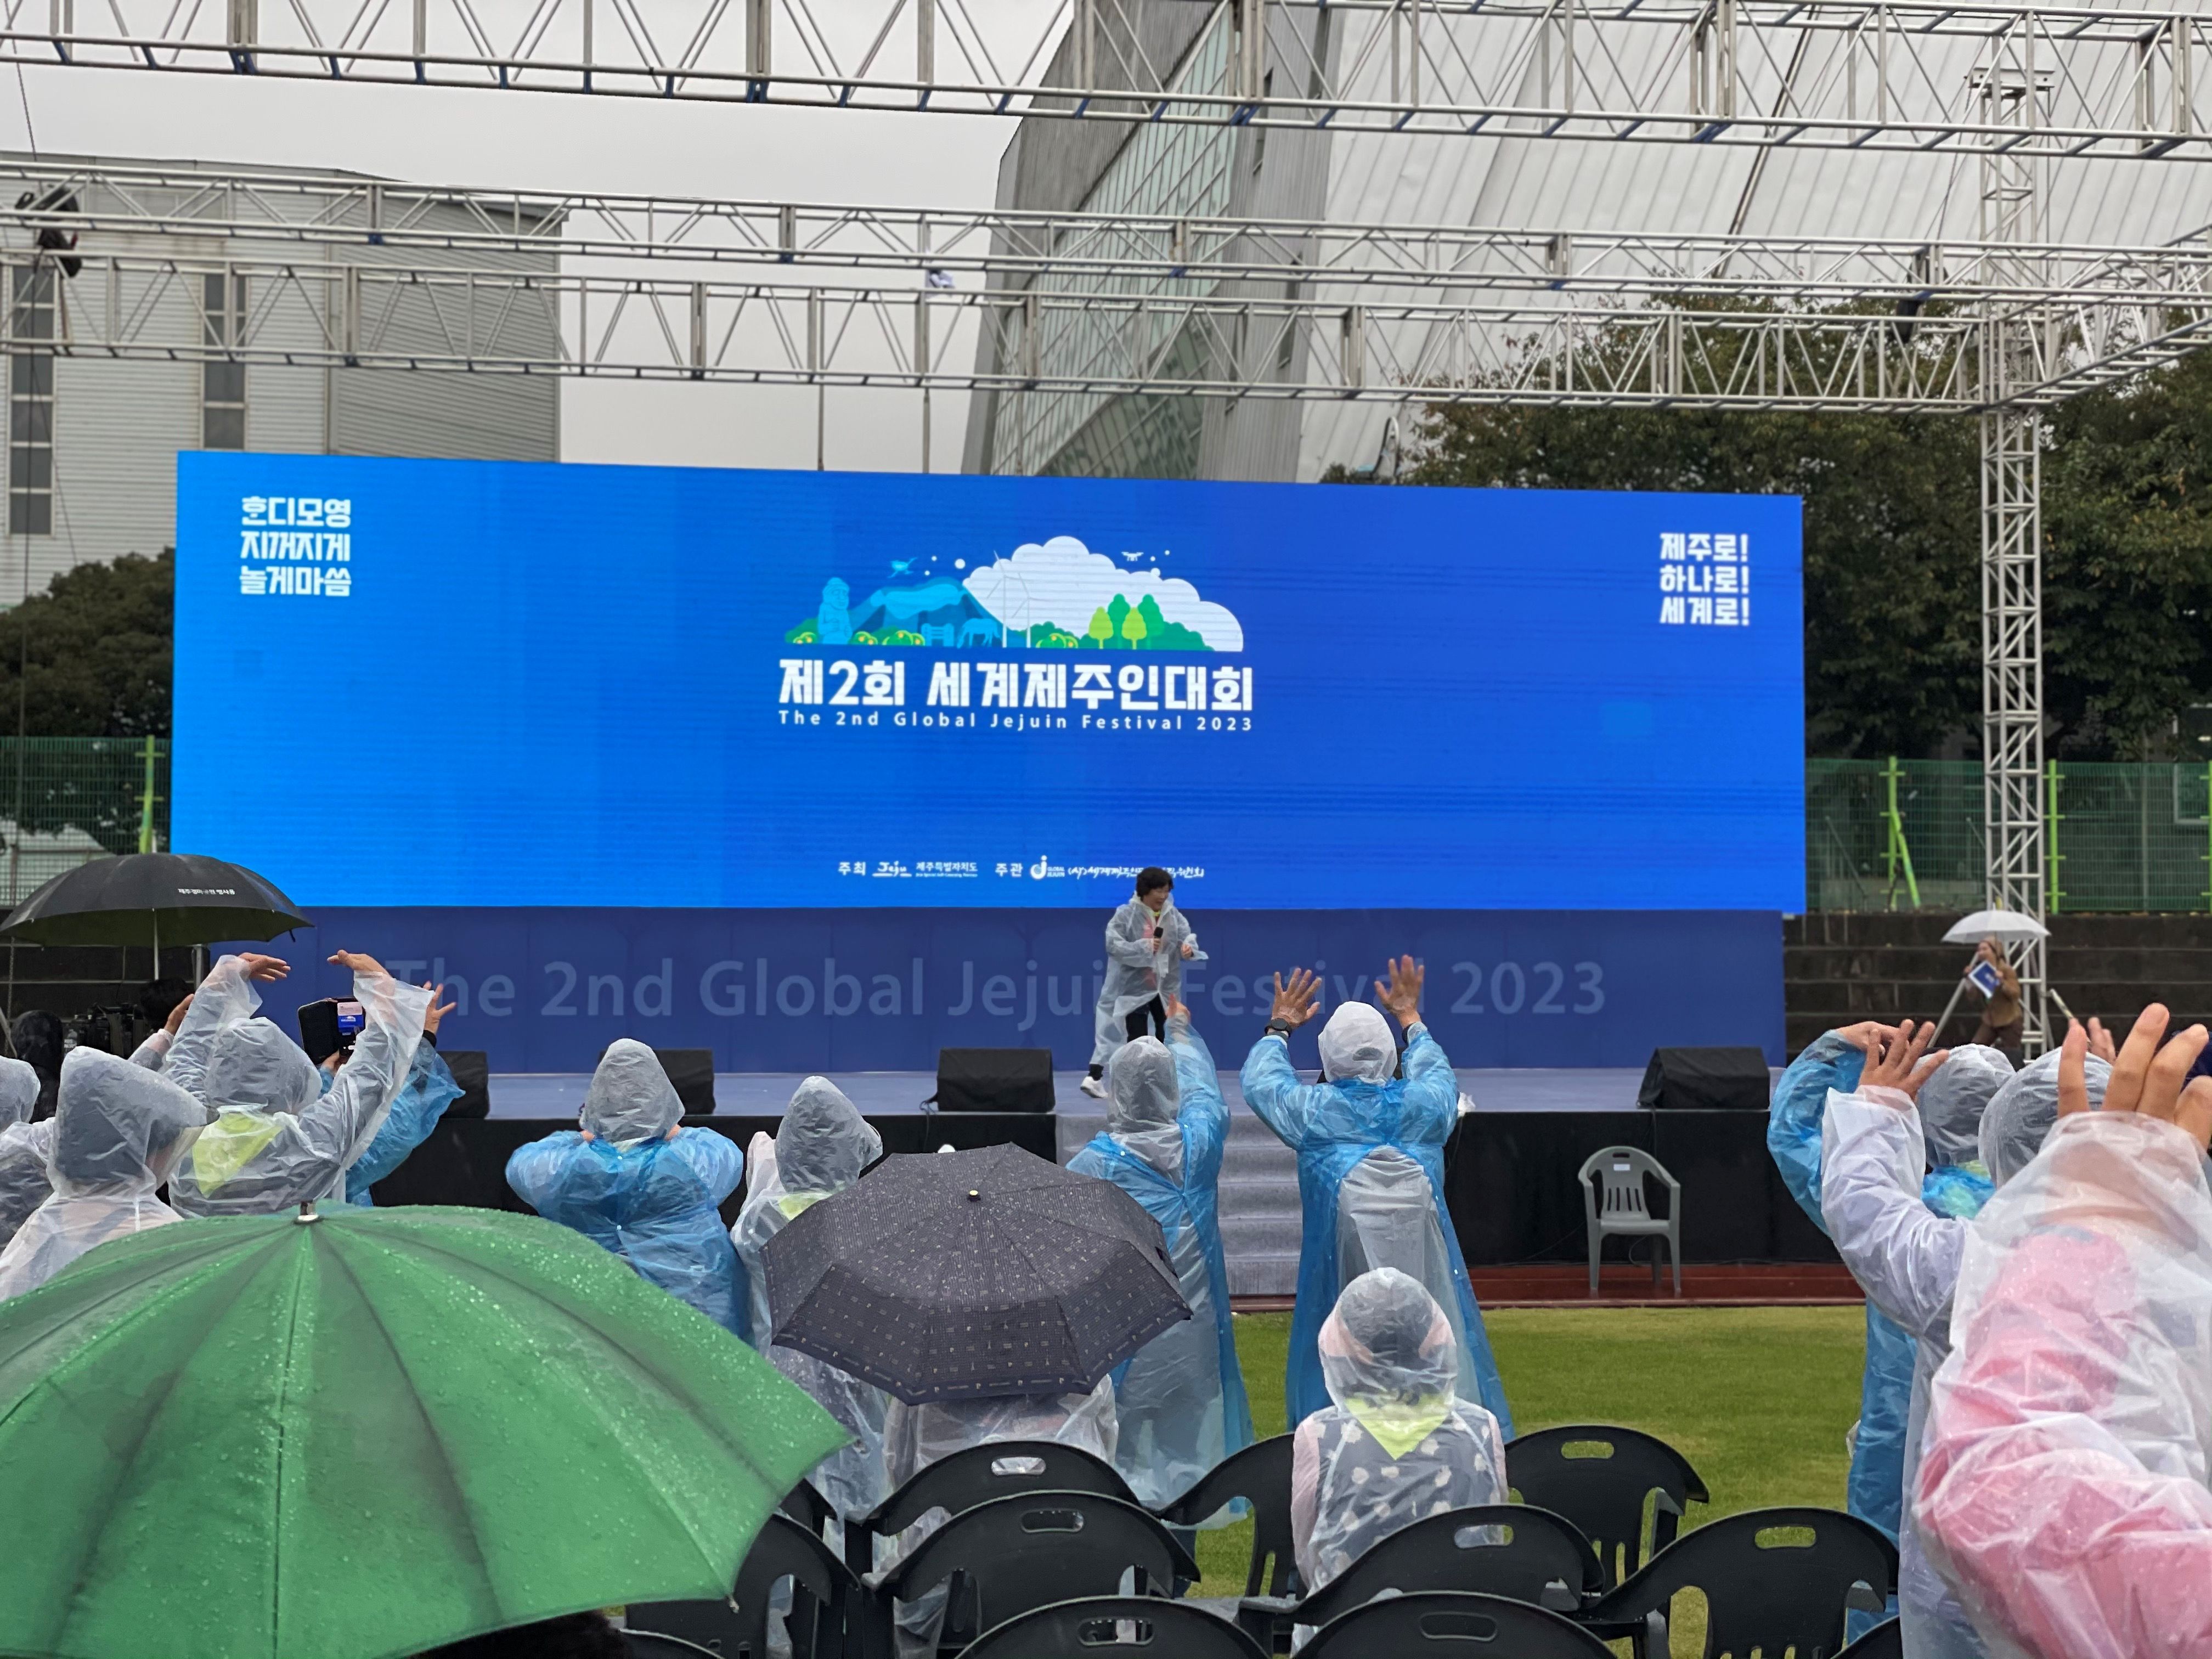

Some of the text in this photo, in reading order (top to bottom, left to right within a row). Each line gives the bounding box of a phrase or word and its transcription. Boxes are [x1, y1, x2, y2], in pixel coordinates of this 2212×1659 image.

[240, 530, 351, 562] 지꺼지게
[1659, 532, 1749, 563] 제주로!
[1659, 564, 1750, 595] 하나로!
[1659, 596, 1750, 627] 세계로!
[778, 659, 1253, 711] 제2회 세계제주인대회
[778, 710, 1252, 731] The 2nd Global Jejuin Festival 2023
[838, 861, 866, 876] 주최
[915, 861, 978, 872] 제주특별자치도
[995, 862, 1023, 877] 주관
[540, 957, 673, 1017] 2nd
[698, 957, 924, 1017] Global
[947, 959, 1104, 1032] Jejui
[1450, 961, 1606, 1015] 2023
